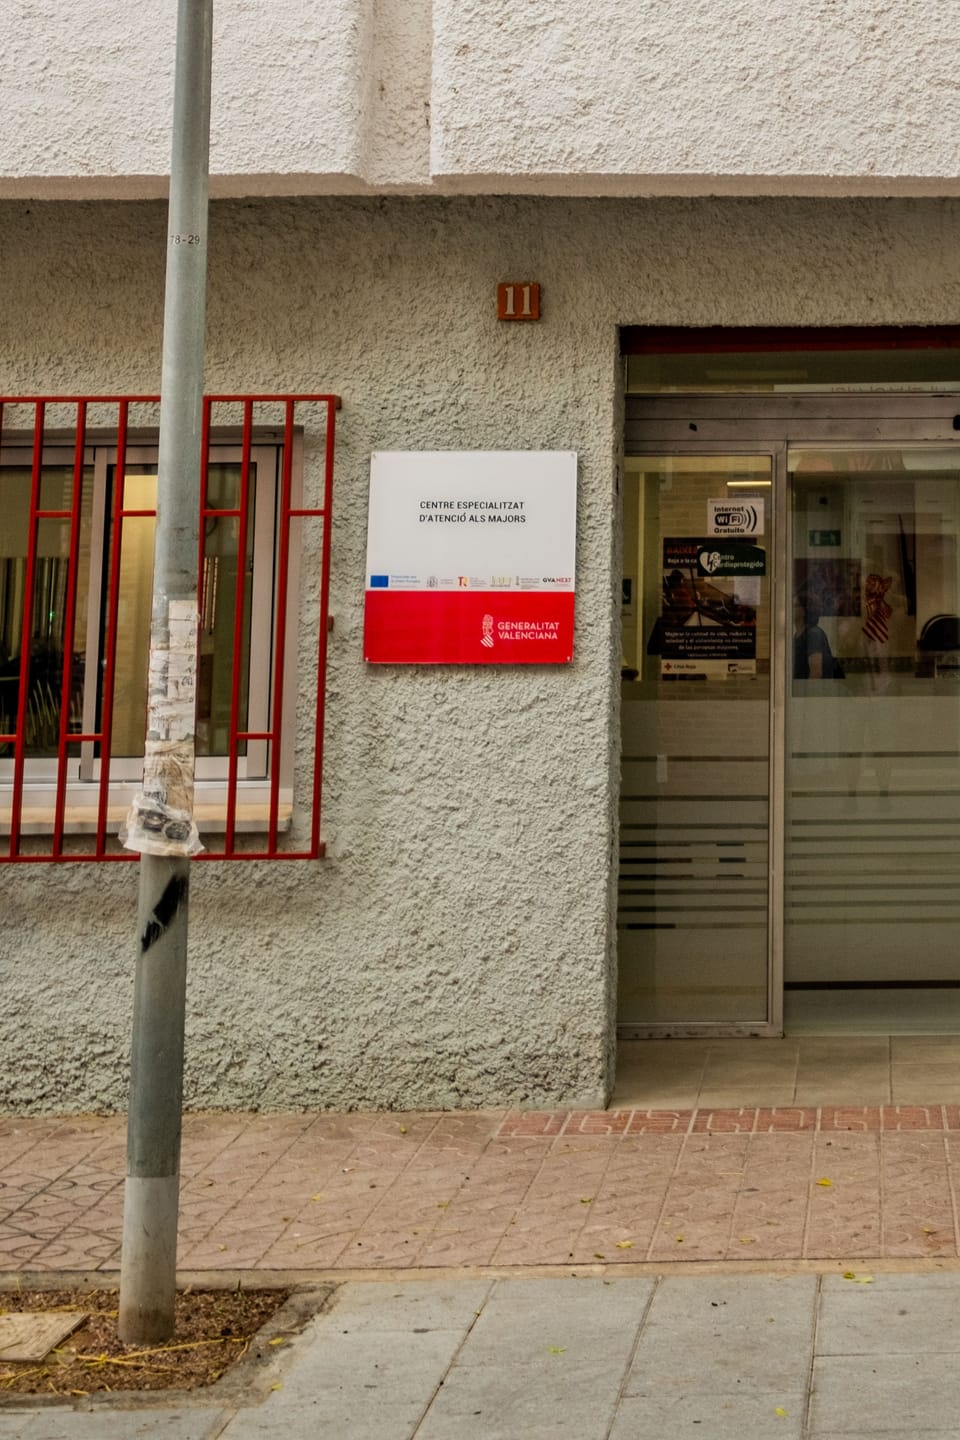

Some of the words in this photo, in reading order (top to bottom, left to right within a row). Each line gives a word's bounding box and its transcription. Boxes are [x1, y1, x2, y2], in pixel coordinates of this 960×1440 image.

[504, 285, 532, 314] 11
[420, 500, 455, 509] CENTRE
[457, 501, 524, 509] ESPECIALITZAT
[419, 512, 466, 523] D'ATENCIÓ
[469, 514, 486, 523] ALS
[488, 514, 526, 523] MAJORS
[713, 561, 764, 569] Cardioprotegido
[497, 621, 560, 630] GENERALITAT
[498, 631, 558, 640] VALENCIANA
